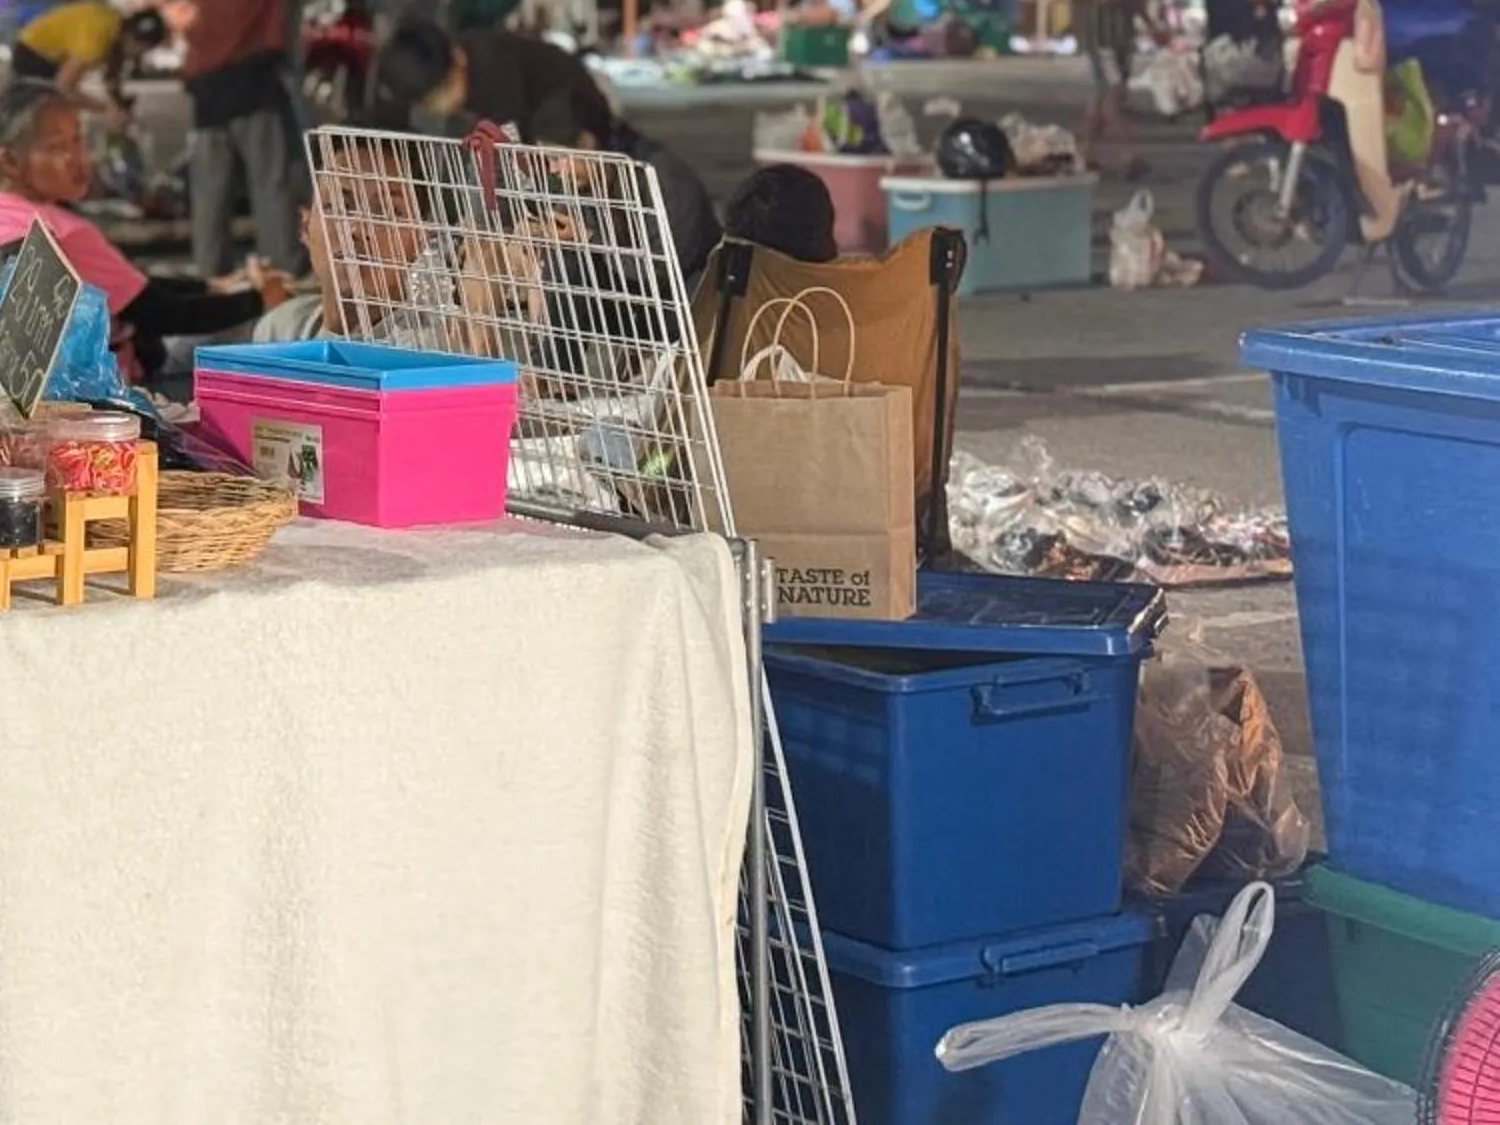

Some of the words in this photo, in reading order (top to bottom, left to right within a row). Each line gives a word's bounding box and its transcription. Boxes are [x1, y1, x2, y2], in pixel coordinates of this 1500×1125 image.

[776, 568, 844, 585] TASTE
[850, 570, 870, 586] of
[777, 586, 871, 606] NATURE
